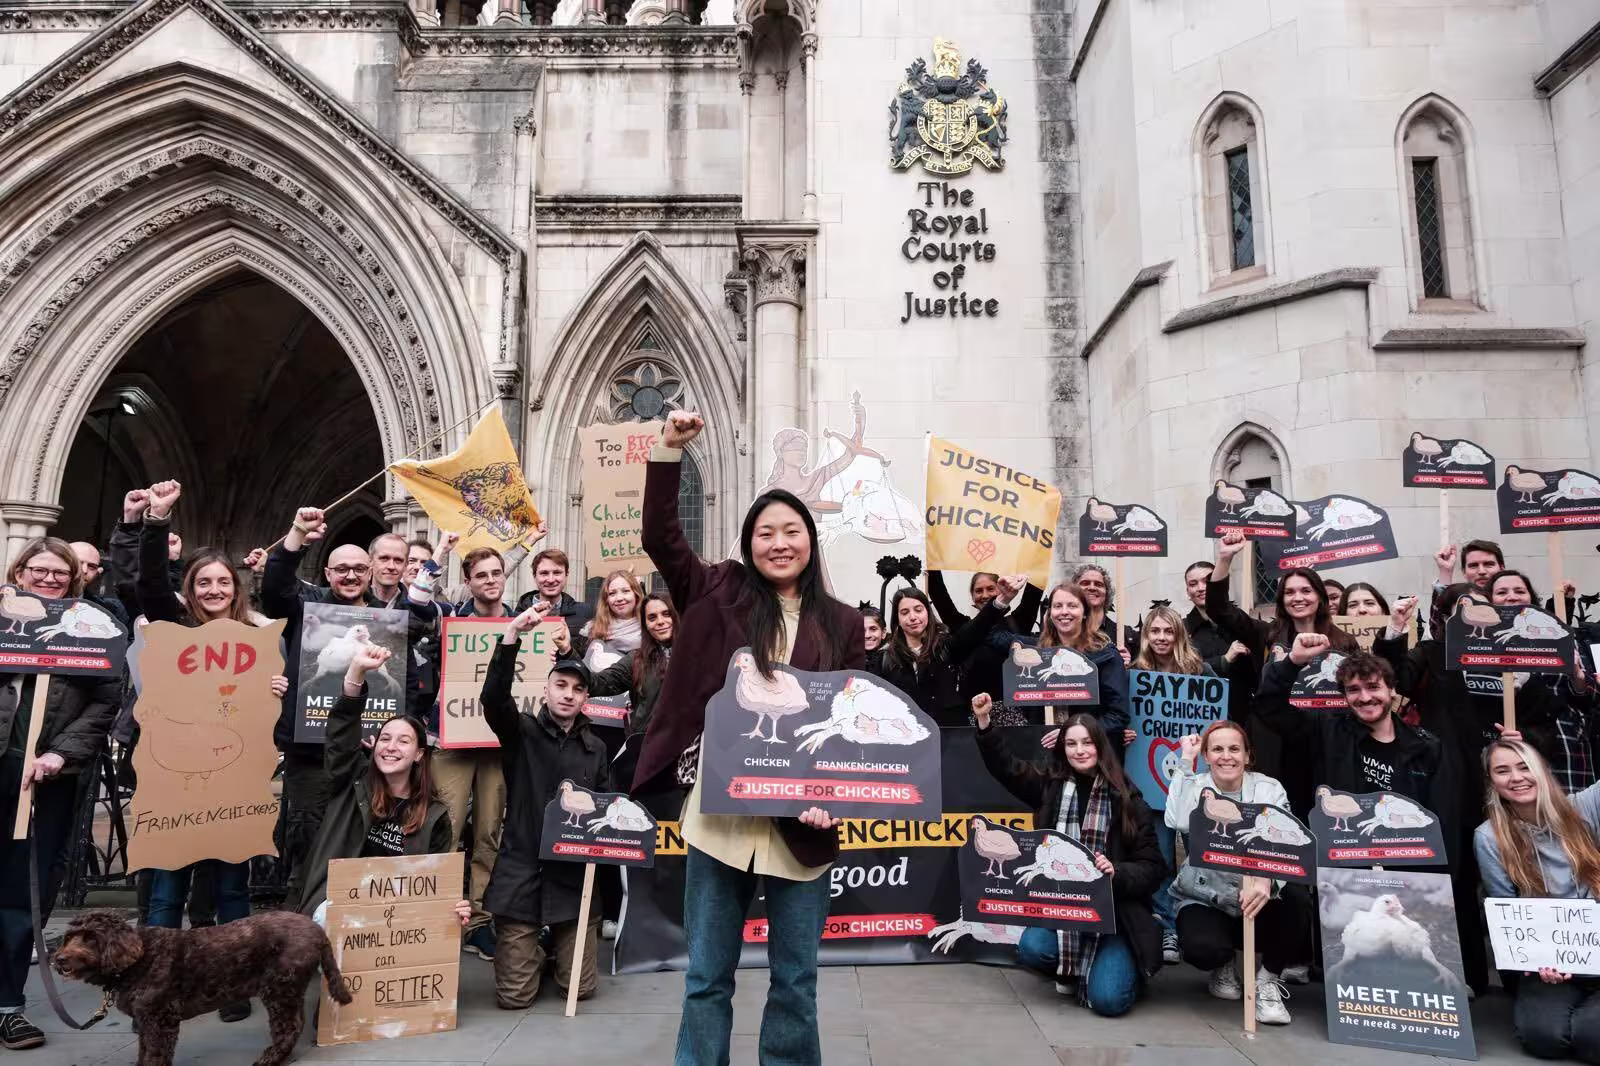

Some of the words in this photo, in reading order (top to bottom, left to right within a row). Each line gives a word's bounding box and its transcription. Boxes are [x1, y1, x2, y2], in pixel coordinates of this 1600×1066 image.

[918, 182, 974, 207] The
[907, 208, 988, 238] Royal
[902, 236, 996, 261] Courts
[933, 264, 966, 290] of
[901, 291, 999, 322] Justice
[595, 439, 622, 452] Too
[628, 435, 658, 450] BIG
[598, 456, 621, 467] Too
[626, 451, 650, 465] FAS
[940, 449, 1047, 493] JUSTICE
[963, 480, 1019, 508] FOR
[592, 504, 641, 521] Chicke
[601, 525, 642, 539] deserv
[925, 505, 1054, 549] CHICKENS
[601, 542, 642, 557] bette
[447, 632, 545, 654] JUSTCE
[177, 641, 256, 675] END
[475, 661, 526, 682] FR
[1136, 672, 1185, 699] SAY
[1188, 678, 1223, 703] NO
[306, 696, 338, 708] ME
[1132, 697, 1154, 716] TO
[1161, 701, 1222, 720] CHICKEN
[744, 757, 790, 767] CHICKEN
[816, 761, 909, 773] FRANKENCHICKEN
[734, 784, 911, 800] #JUSTICEFORCHICKENS
[133, 802, 279, 836] FRANKENCHICKENS
[370, 825, 402, 844] EAGUE
[1210, 842, 1234, 850] CHICKEN
[349, 888, 360, 900] a
[369, 876, 437, 898] NATION
[830, 857, 908, 897] good
[985, 887, 1014, 895] CHICKEN
[1029, 890, 1091, 900] FRANKENCHICKEN
[384, 905, 395, 928] of
[1494, 903, 1534, 920] THE
[1550, 906, 1592, 924] TIME
[344, 934, 384, 950] ANIMAL
[390, 928, 427, 946] LOVERS
[1500, 926, 1541, 942] FOR
[375, 955, 395, 968] can
[1509, 945, 1529, 963] IS
[375, 974, 444, 1002] BETTER
[1336, 984, 1399, 1004] MEET
[1407, 992, 1457, 1011] THE
[1338, 1002, 1458, 1022] FRANKENCHICKEN
[1340, 1016, 1359, 1026] she
[1363, 1019, 1397, 1030] needs
[1400, 1024, 1429, 1034] your
[1434, 1027, 1460, 1039] help
